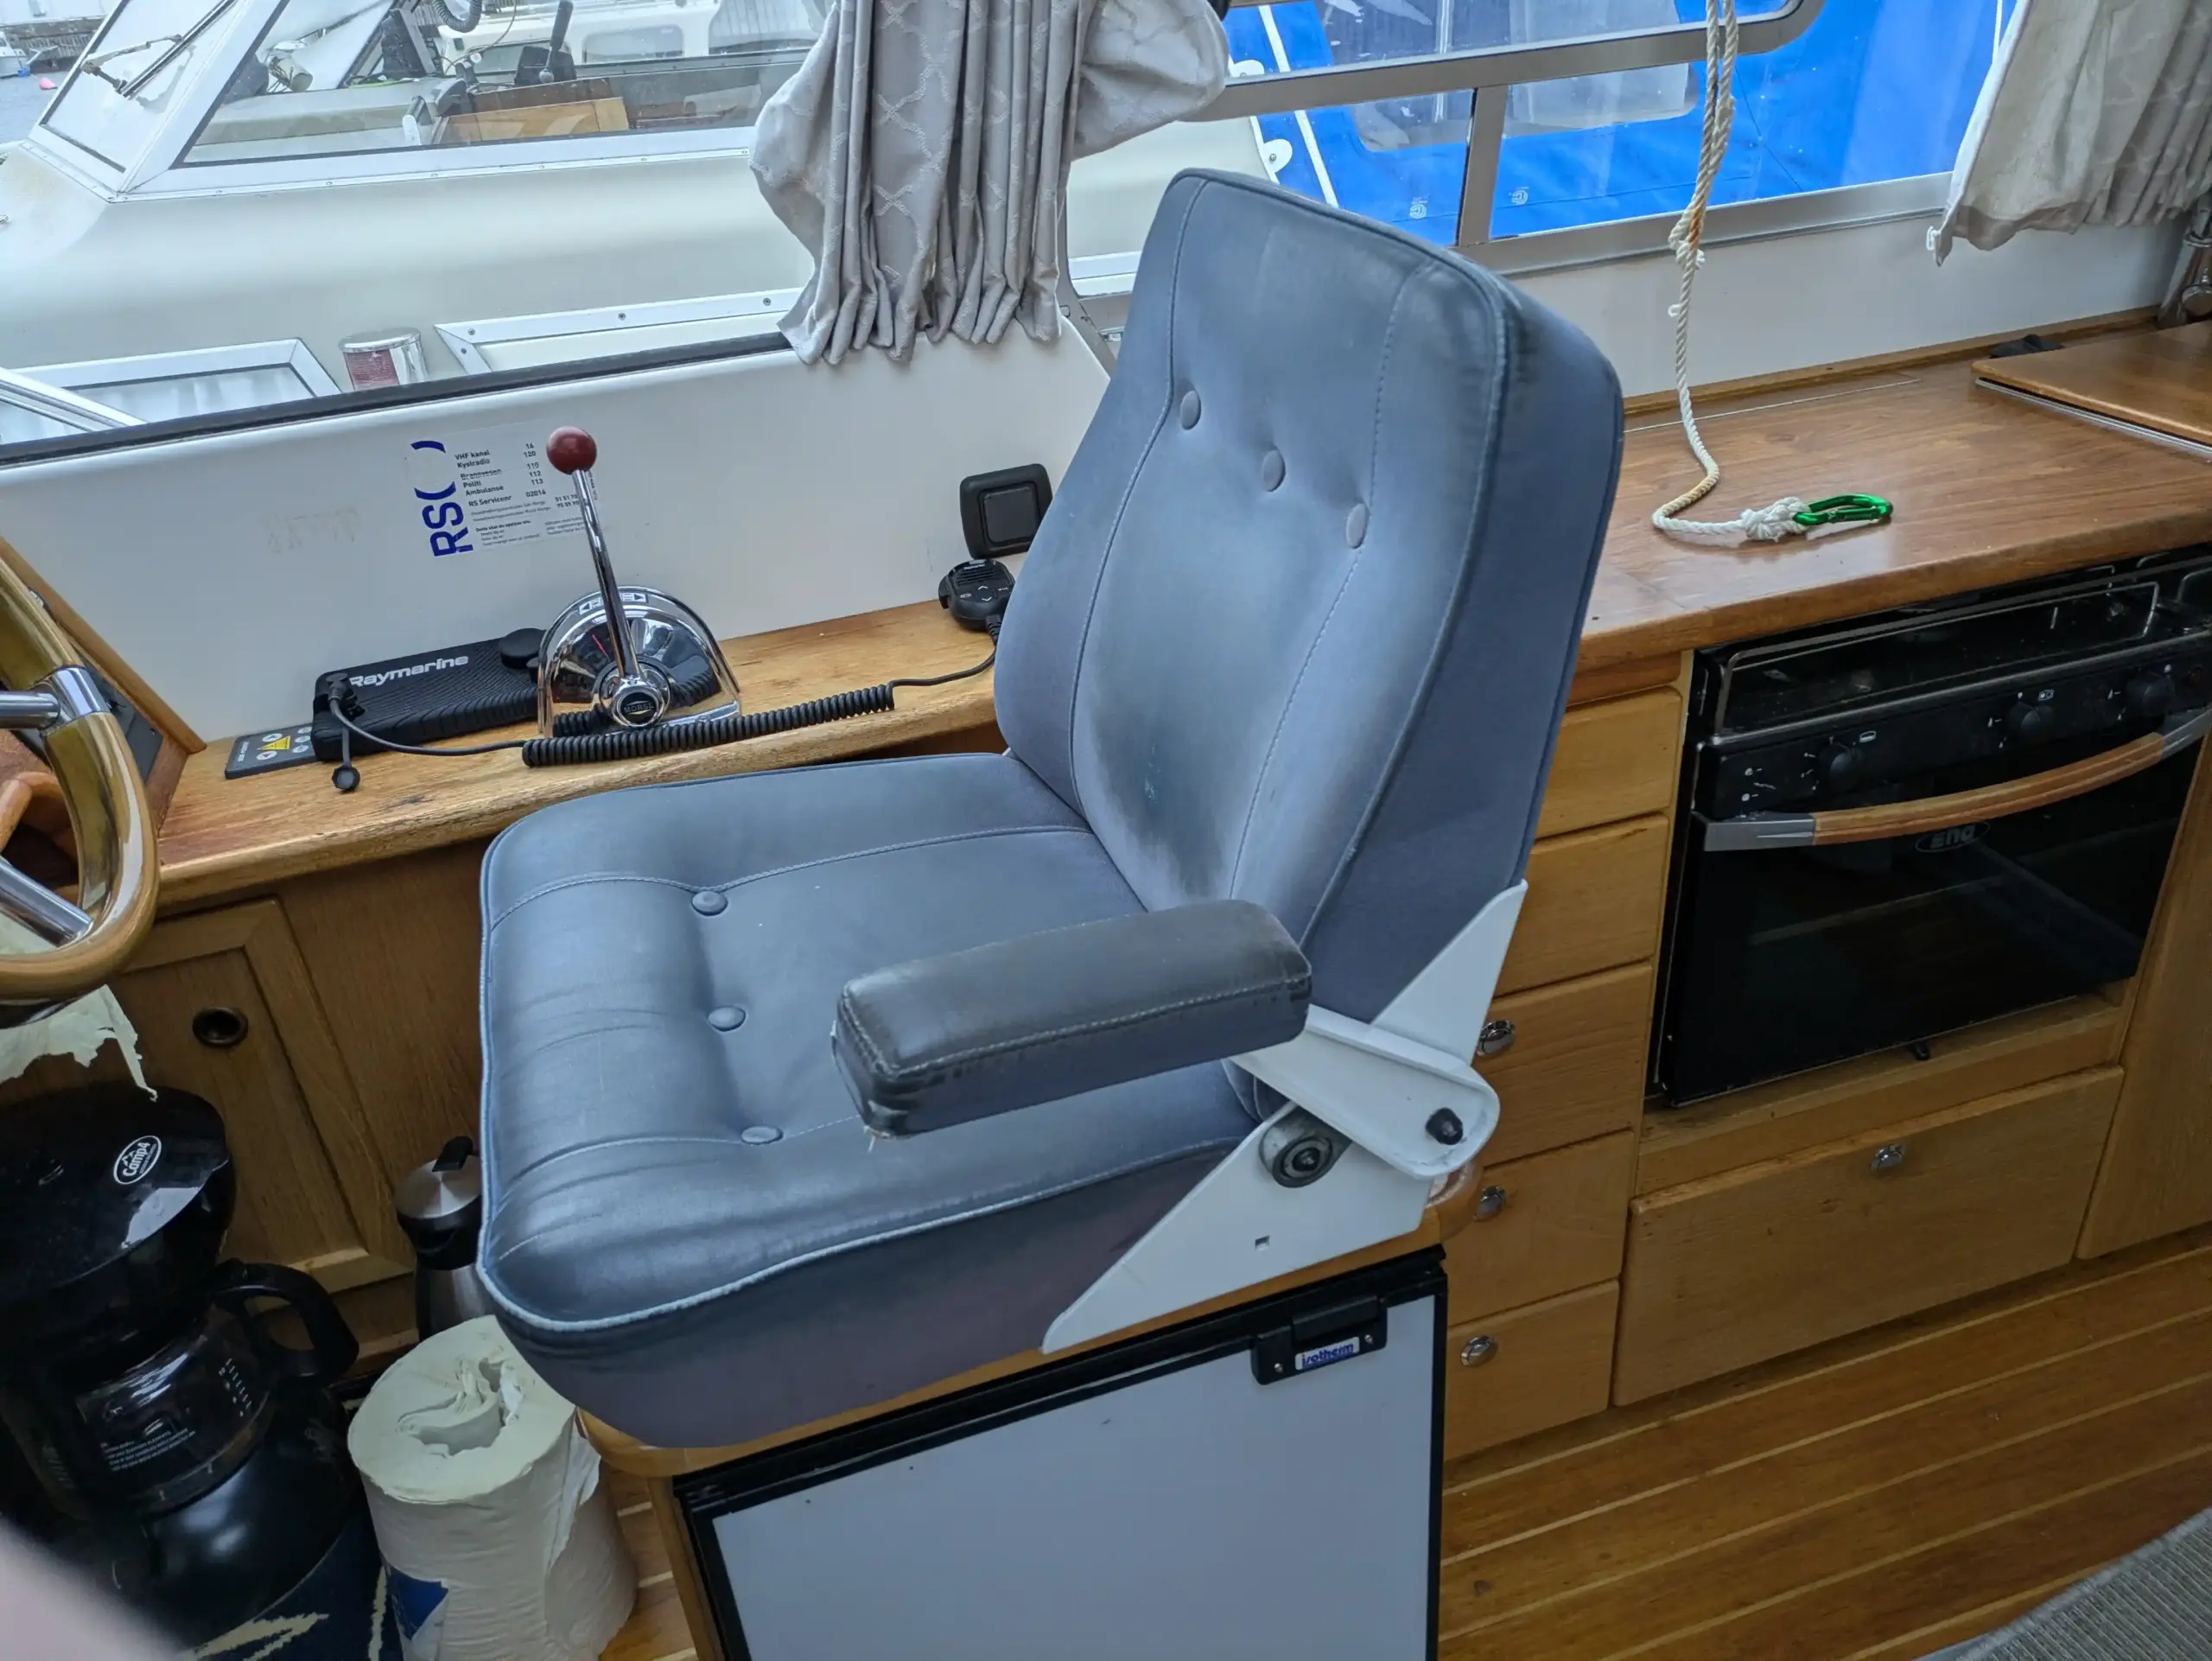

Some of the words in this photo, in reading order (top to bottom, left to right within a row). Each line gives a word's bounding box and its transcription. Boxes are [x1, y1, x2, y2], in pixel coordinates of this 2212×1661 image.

[454, 452, 469, 461] VHF
[470, 449, 491, 458] kanal
[456, 458, 491, 468] Kystradio
[462, 480, 482, 488] Politi
[465, 485, 505, 496] Ambulanse
[479, 495, 512, 506] Servicenr
[525, 489, 547, 498] 02016
[349, 656, 469, 687] Raymarine
[623, 702, 654, 714] MORSE
[122, 1142, 150, 1176] Camp4
[1301, 1343, 1354, 1367] isotherm
